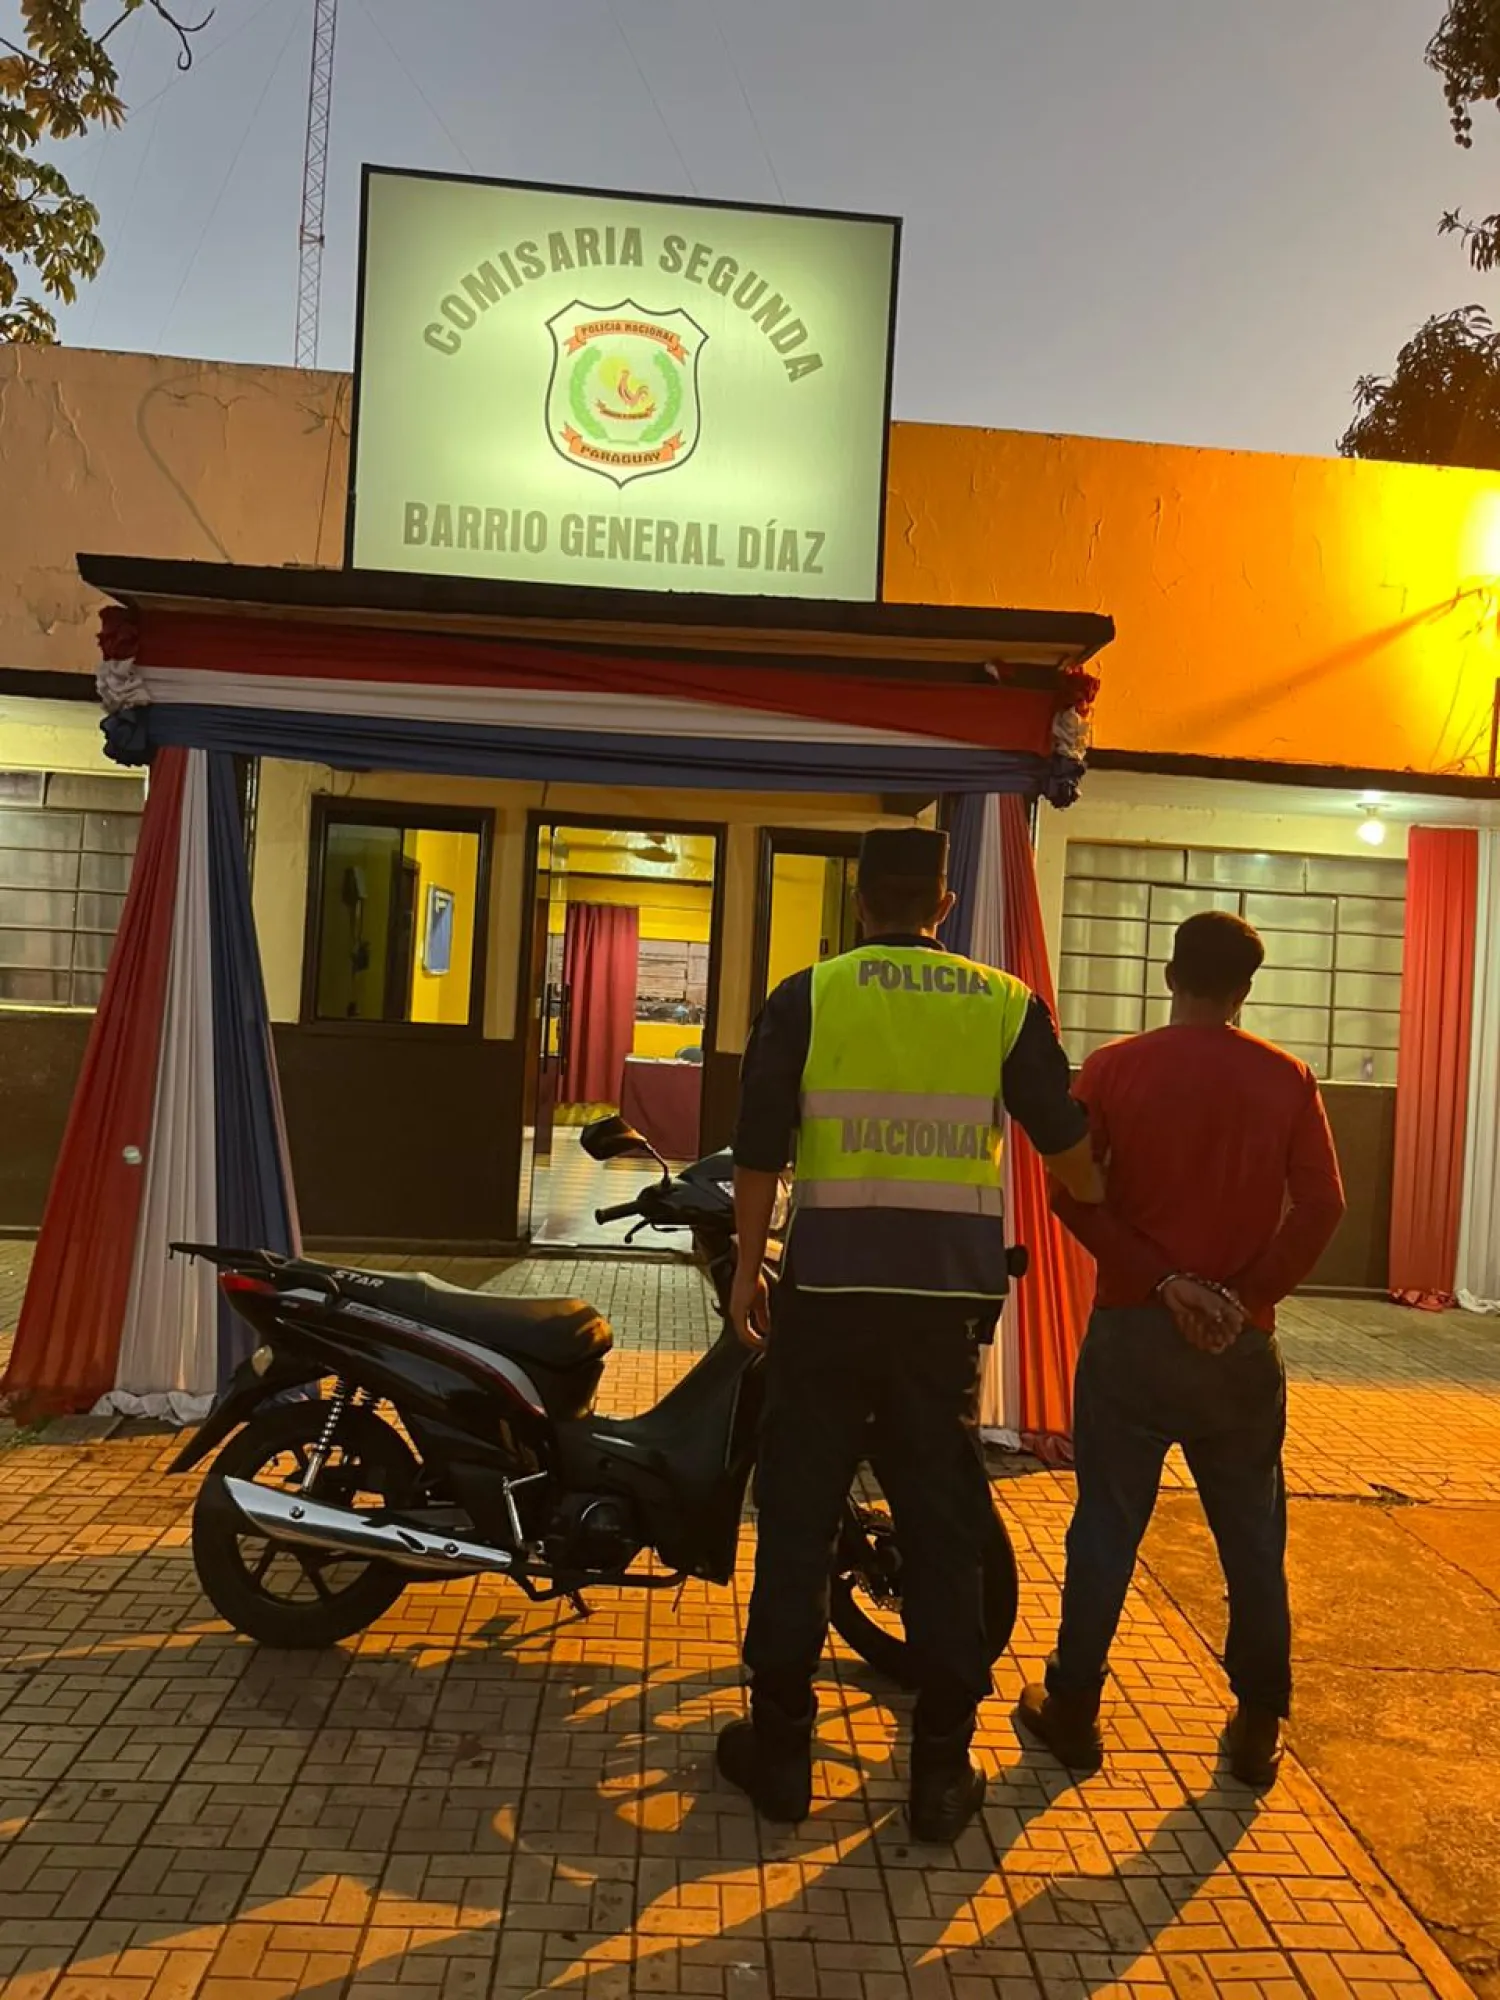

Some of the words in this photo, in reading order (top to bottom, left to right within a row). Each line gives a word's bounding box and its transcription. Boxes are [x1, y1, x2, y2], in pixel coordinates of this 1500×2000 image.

[424, 226, 643, 356] COMISARIA
[659, 235, 823, 383] SEGUNDA
[625, 323, 674, 342] NACIONAL
[580, 445, 661, 464] PARAGUAY
[403, 502, 547, 554] BARRIO
[560, 514, 725, 567] GENERAL
[737, 519, 826, 574] DÍAZ
[858, 960, 992, 995] POLICIA
[332, 1269, 384, 1288] STAR
